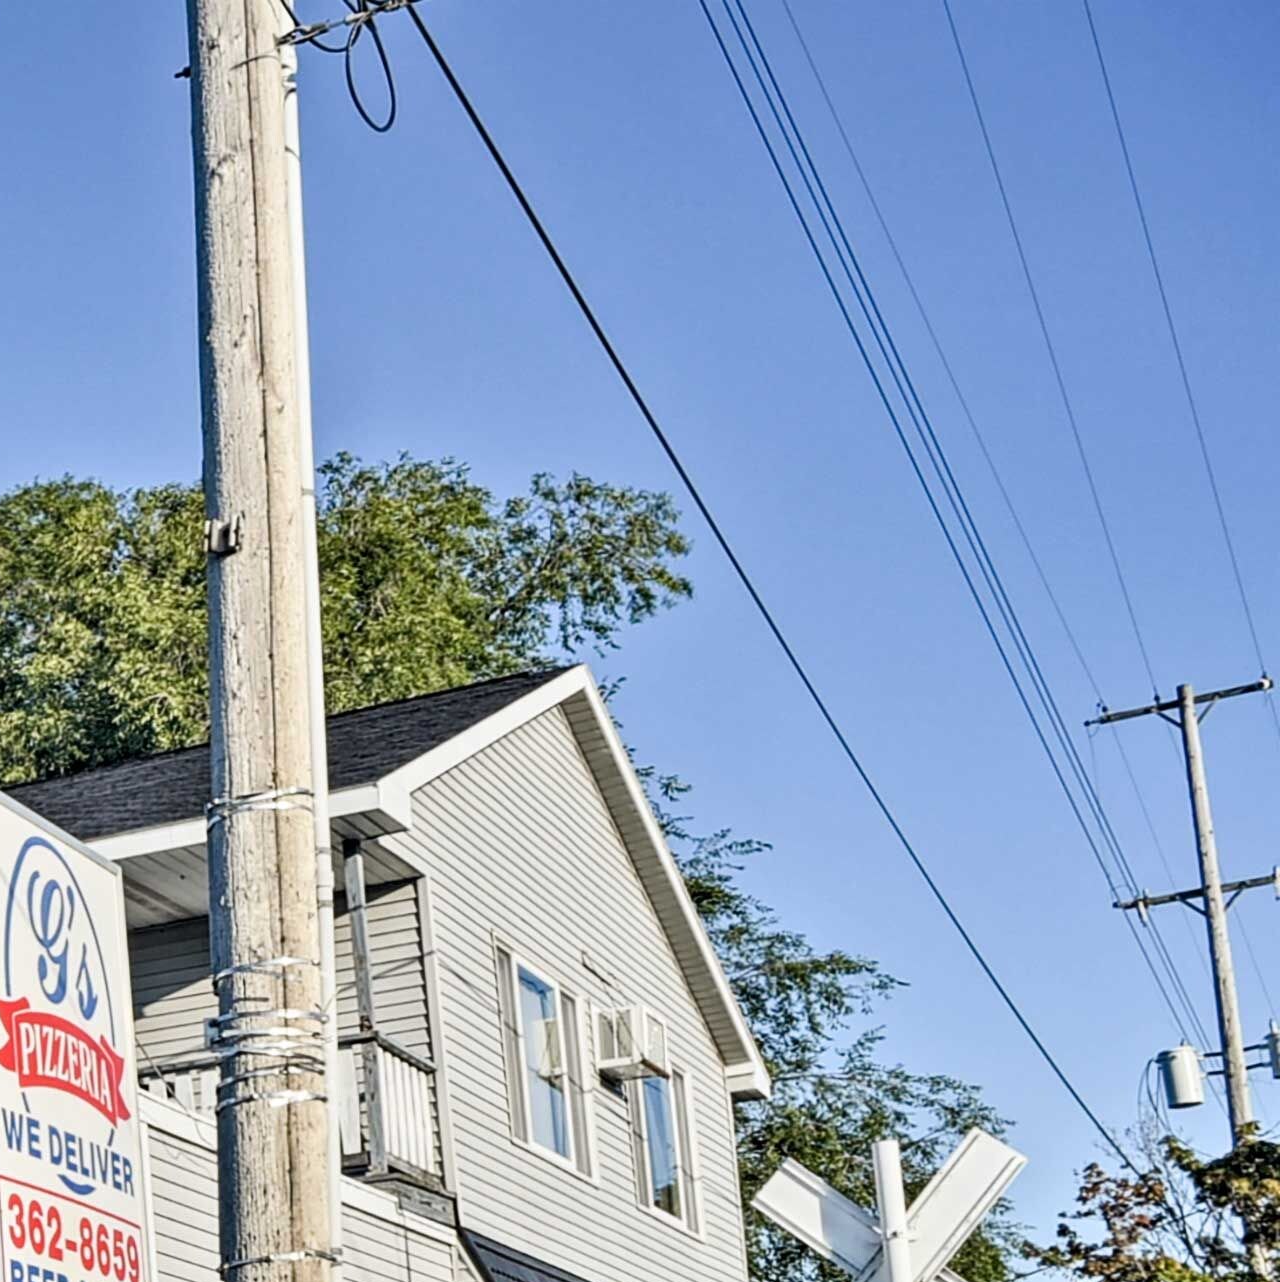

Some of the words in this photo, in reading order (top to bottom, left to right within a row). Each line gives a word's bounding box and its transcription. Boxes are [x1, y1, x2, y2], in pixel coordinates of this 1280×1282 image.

[19, 1021, 113, 1113] PIZZERIA
[1, 1107, 42, 1160] WE
[47, 1124, 135, 1197] DELIVER
